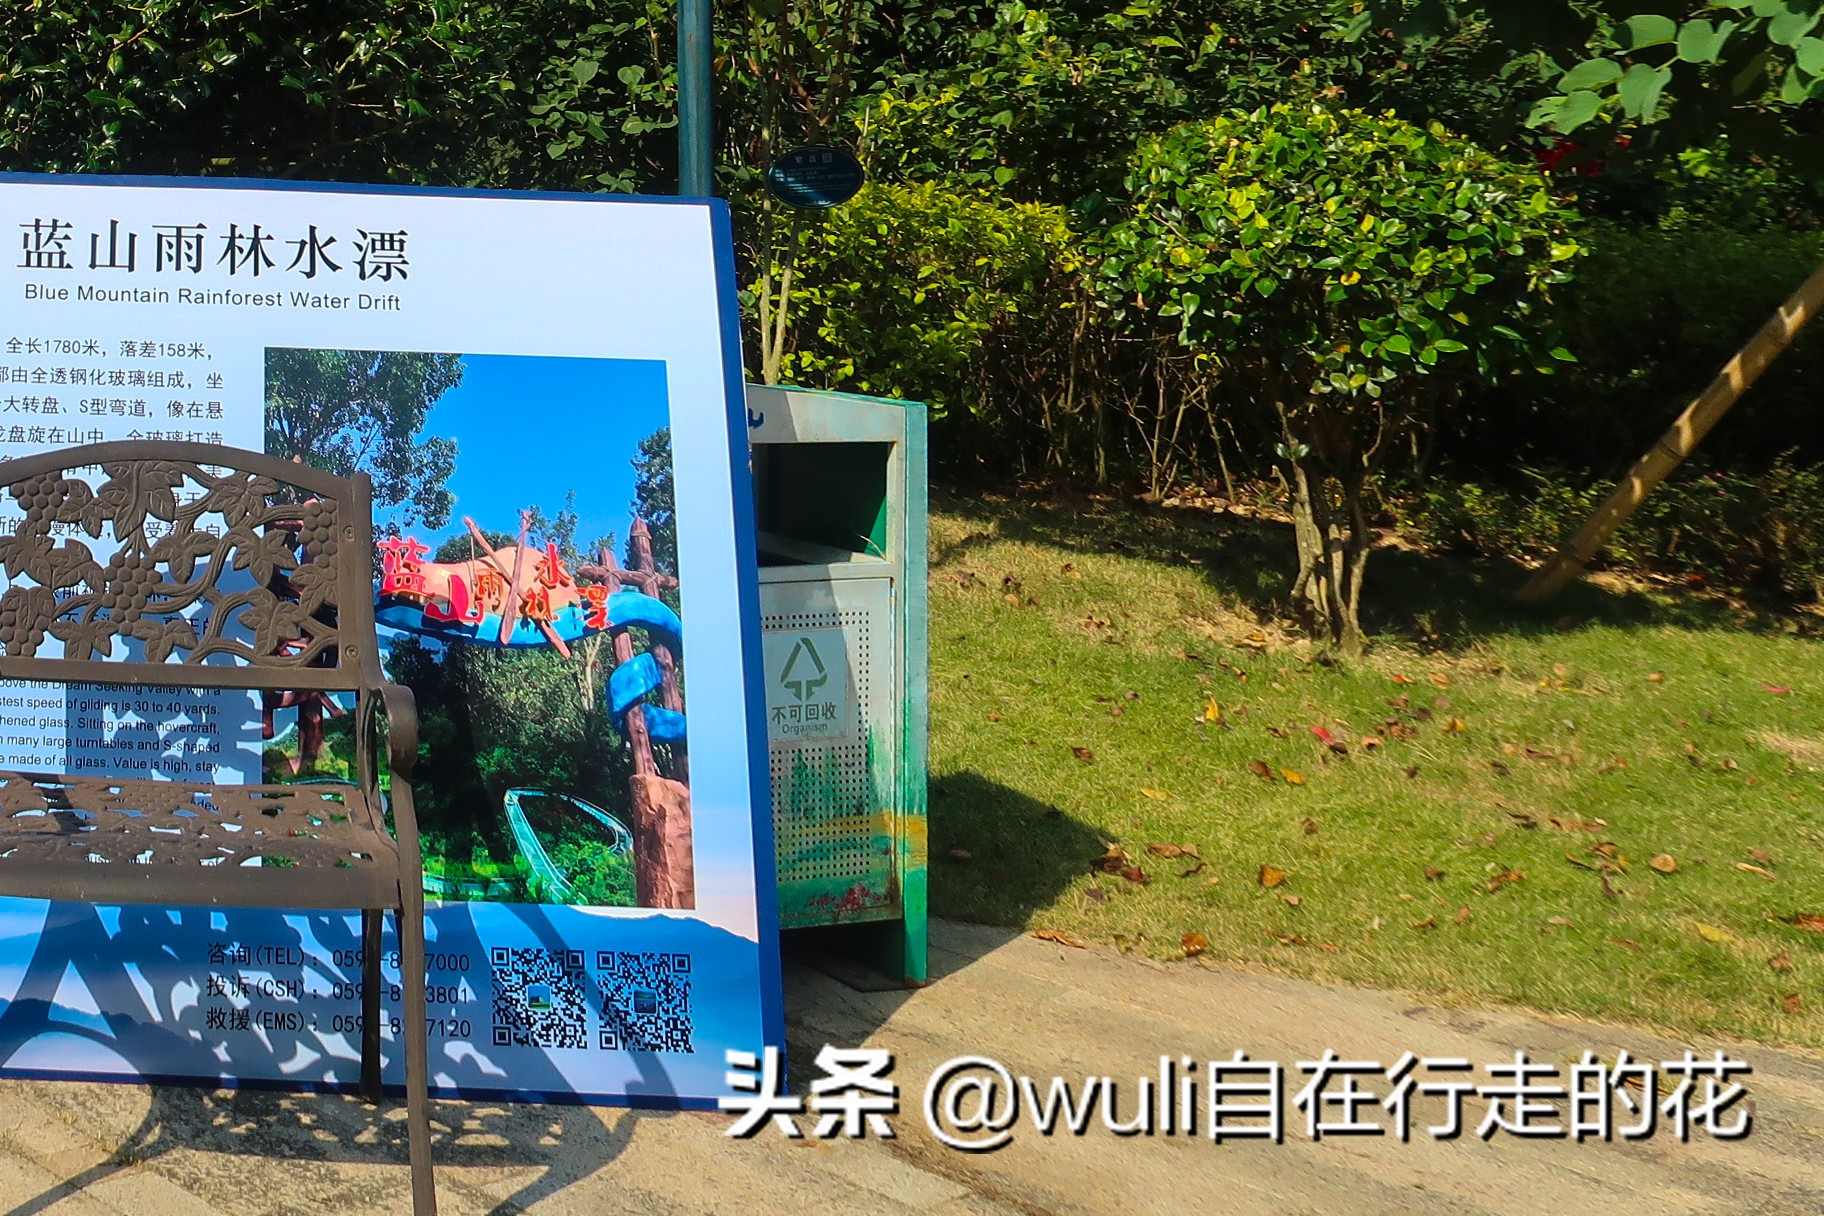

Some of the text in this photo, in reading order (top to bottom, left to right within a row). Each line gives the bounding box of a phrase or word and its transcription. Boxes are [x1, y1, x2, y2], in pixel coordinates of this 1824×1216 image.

[16, 218, 409, 282] 蓝山雨林水漂
[25, 284, 400, 311] Blue Mountain Rainforest Water Drift
[27, 697, 62, 712] speed
[80, 698, 118, 714] gliding
[772, 702, 837, 724] 不可回收
[78, 717, 113, 732] Sitting
[782, 723, 828, 735] Organism
[7, 736, 39, 748] many
[43, 735, 72, 750] large
[8, 752, 41, 765] made
[59, 754, 72, 766] all
[113, 757, 147, 769] Value
[196, 760, 222, 775] stay
